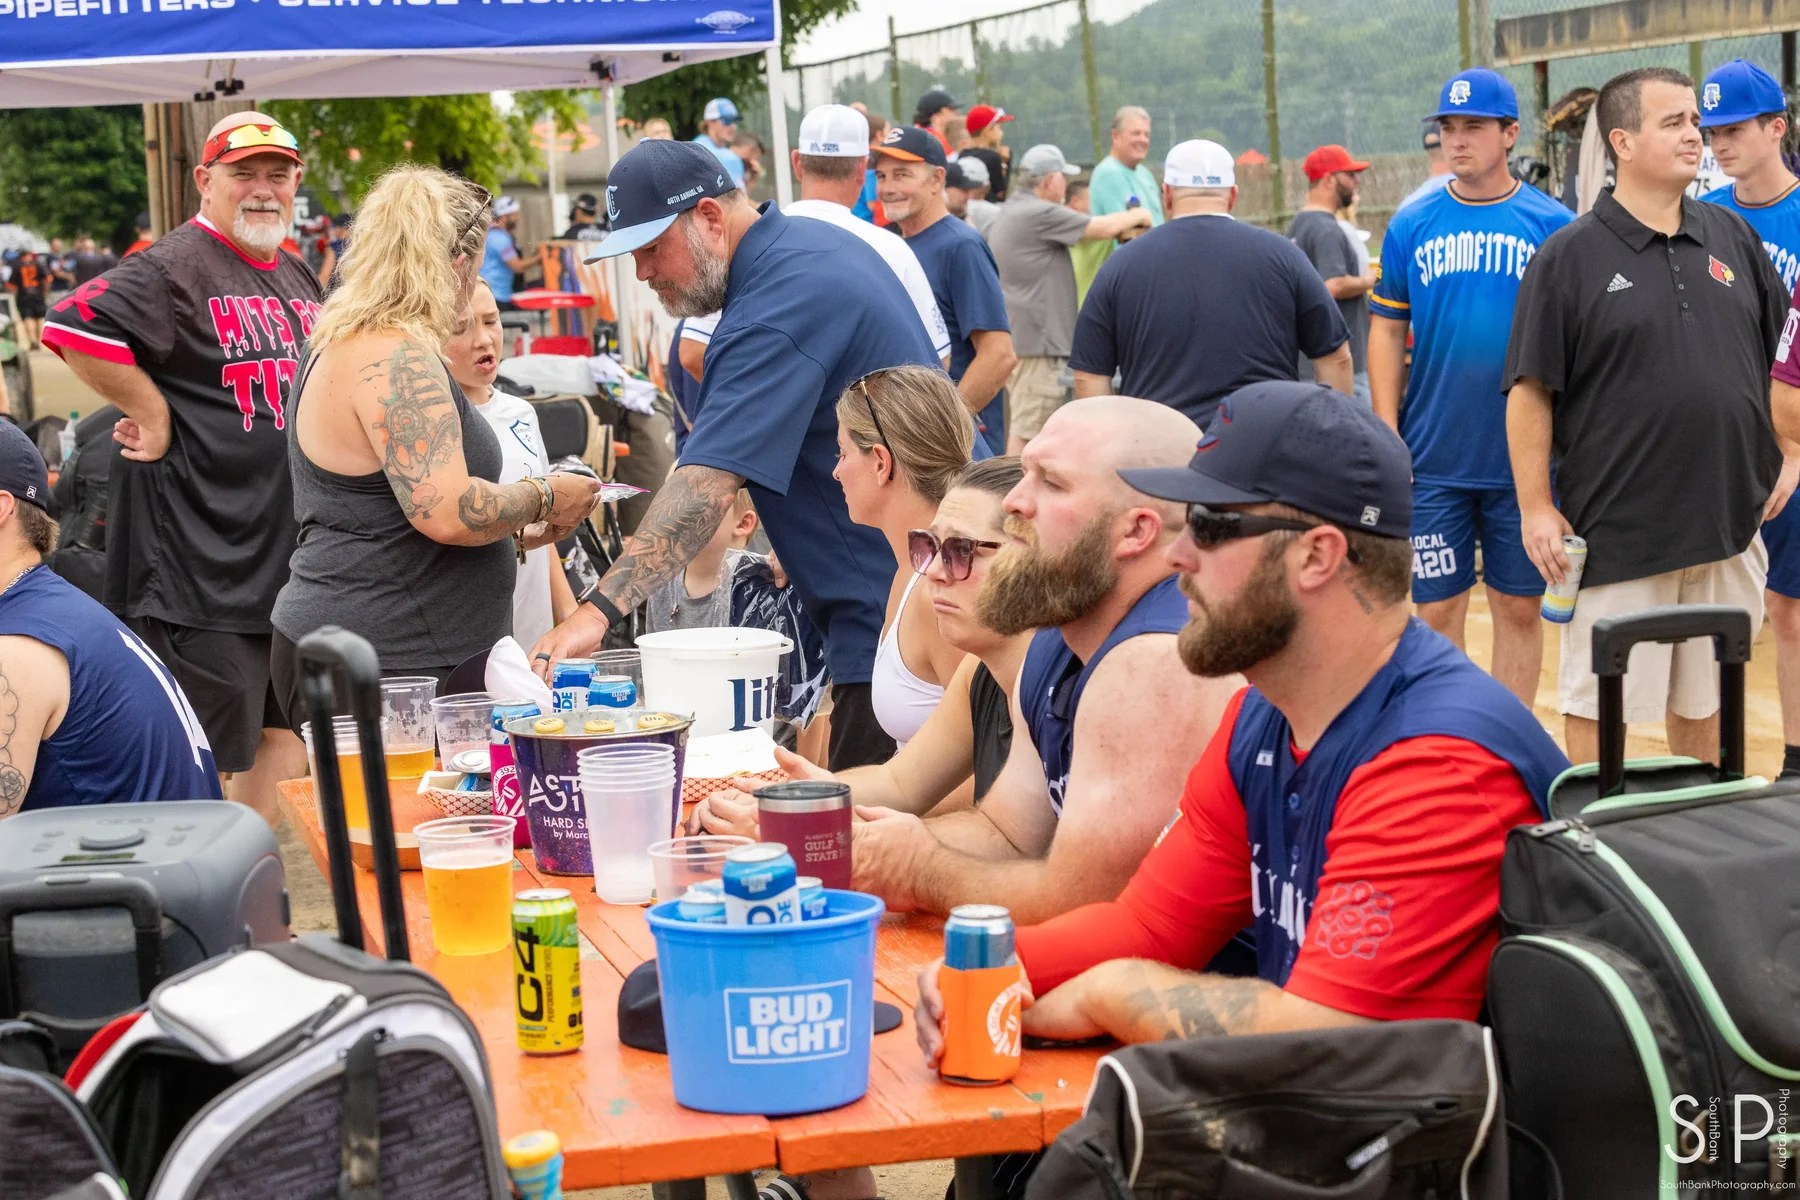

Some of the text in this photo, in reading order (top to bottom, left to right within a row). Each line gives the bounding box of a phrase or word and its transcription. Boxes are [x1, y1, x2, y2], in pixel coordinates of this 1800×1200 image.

[208, 295, 300, 359] HITS
[1409, 533, 1447, 550] LOCAL
[1411, 547, 1457, 579] 420
[543, 816, 574, 830] HARD
[553, 828, 590, 840] by Marc
[804, 839, 834, 852] GULF
[805, 849, 839, 863] STATE
[514, 926, 544, 1022] C4
[749, 991, 833, 1026] BUD
[734, 1018, 845, 1055] LIGHT
